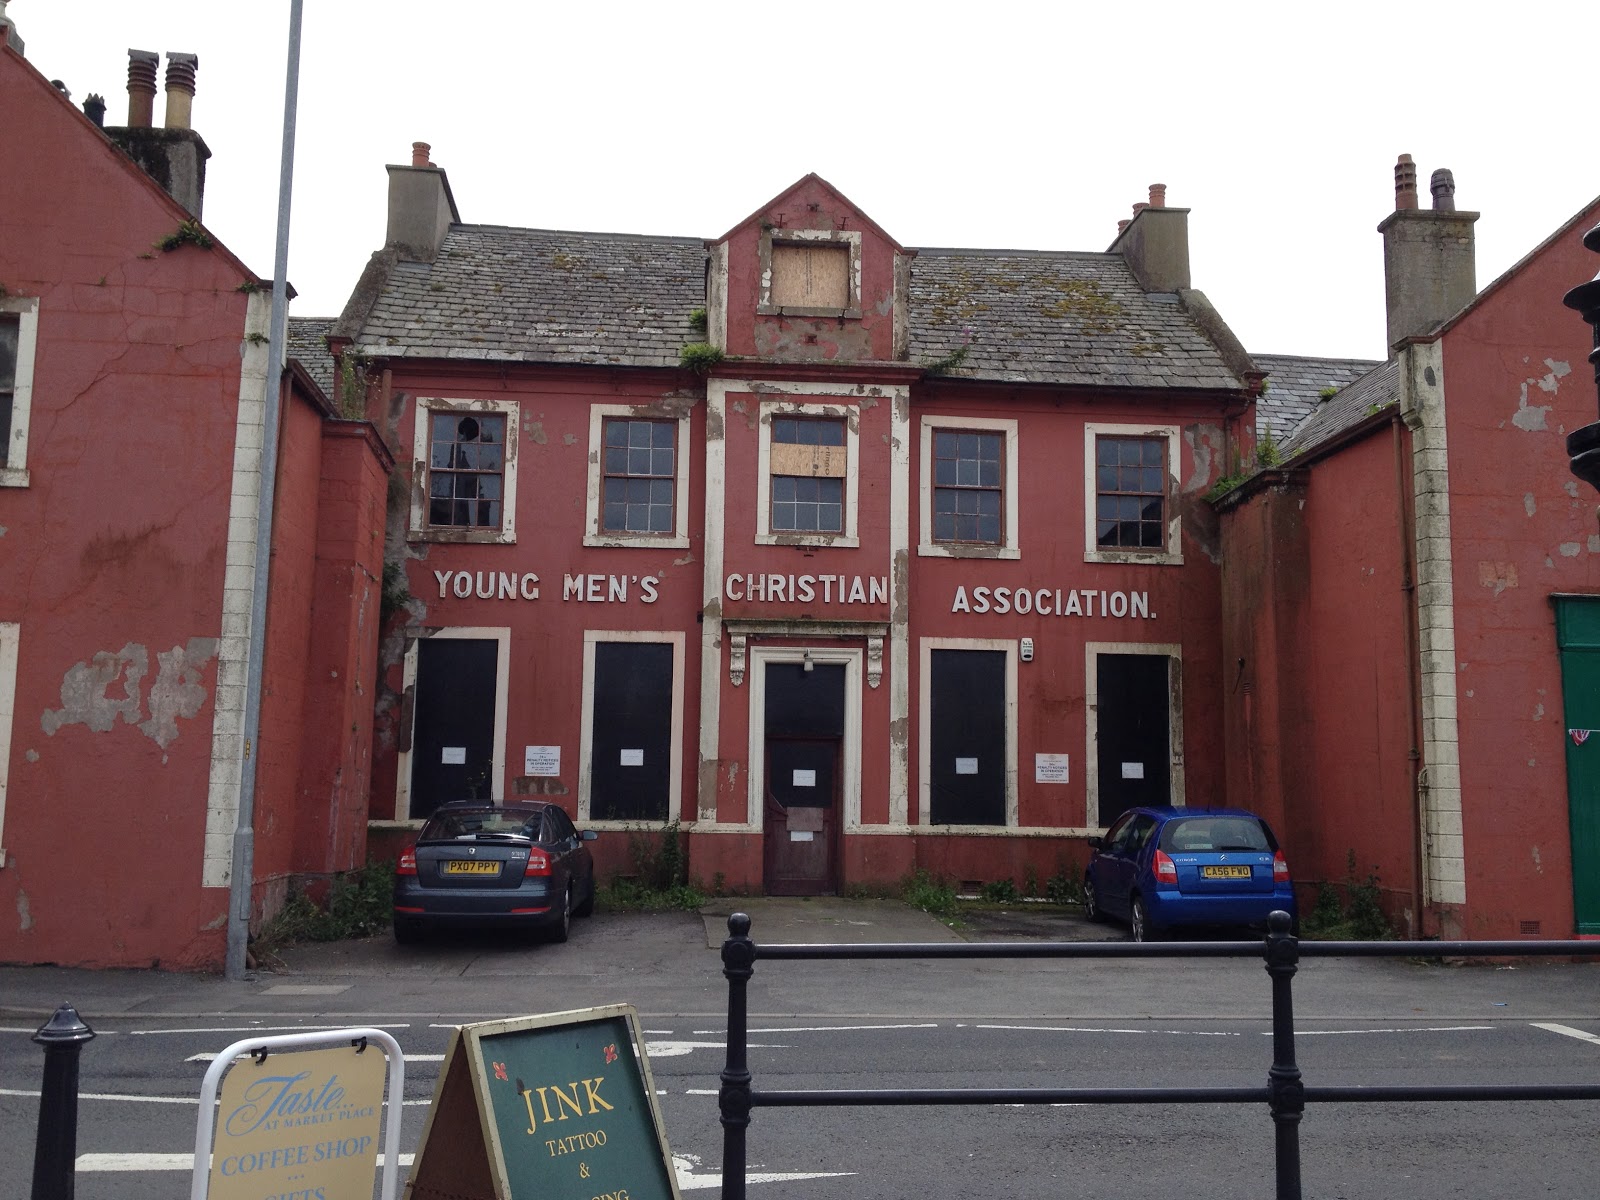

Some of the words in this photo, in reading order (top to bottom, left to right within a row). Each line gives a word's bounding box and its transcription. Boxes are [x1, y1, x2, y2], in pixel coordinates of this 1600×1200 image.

[433, 570, 539, 600] YOUNG
[563, 573, 660, 603] MEN'S
[725, 573, 888, 604] CHRISTIAN
[951, 585, 1157, 619] ASSOCIATION.
[450, 861, 476, 871] PX07
[477, 862, 497, 872] PPY
[1205, 866, 1229, 876] CA56
[1231, 866, 1249, 876] FWO
[264, 1120, 280, 1131] AT
[284, 1112, 334, 1128] MARKET
[339, 1105, 374, 1121] PLACE
[522, 1077, 615, 1135] JINK
[220, 1145, 309, 1177] COFFEE
[313, 1135, 372, 1163] SHOP
[545, 1129, 607, 1157] TATTOO
[579, 1162, 591, 1179] &
